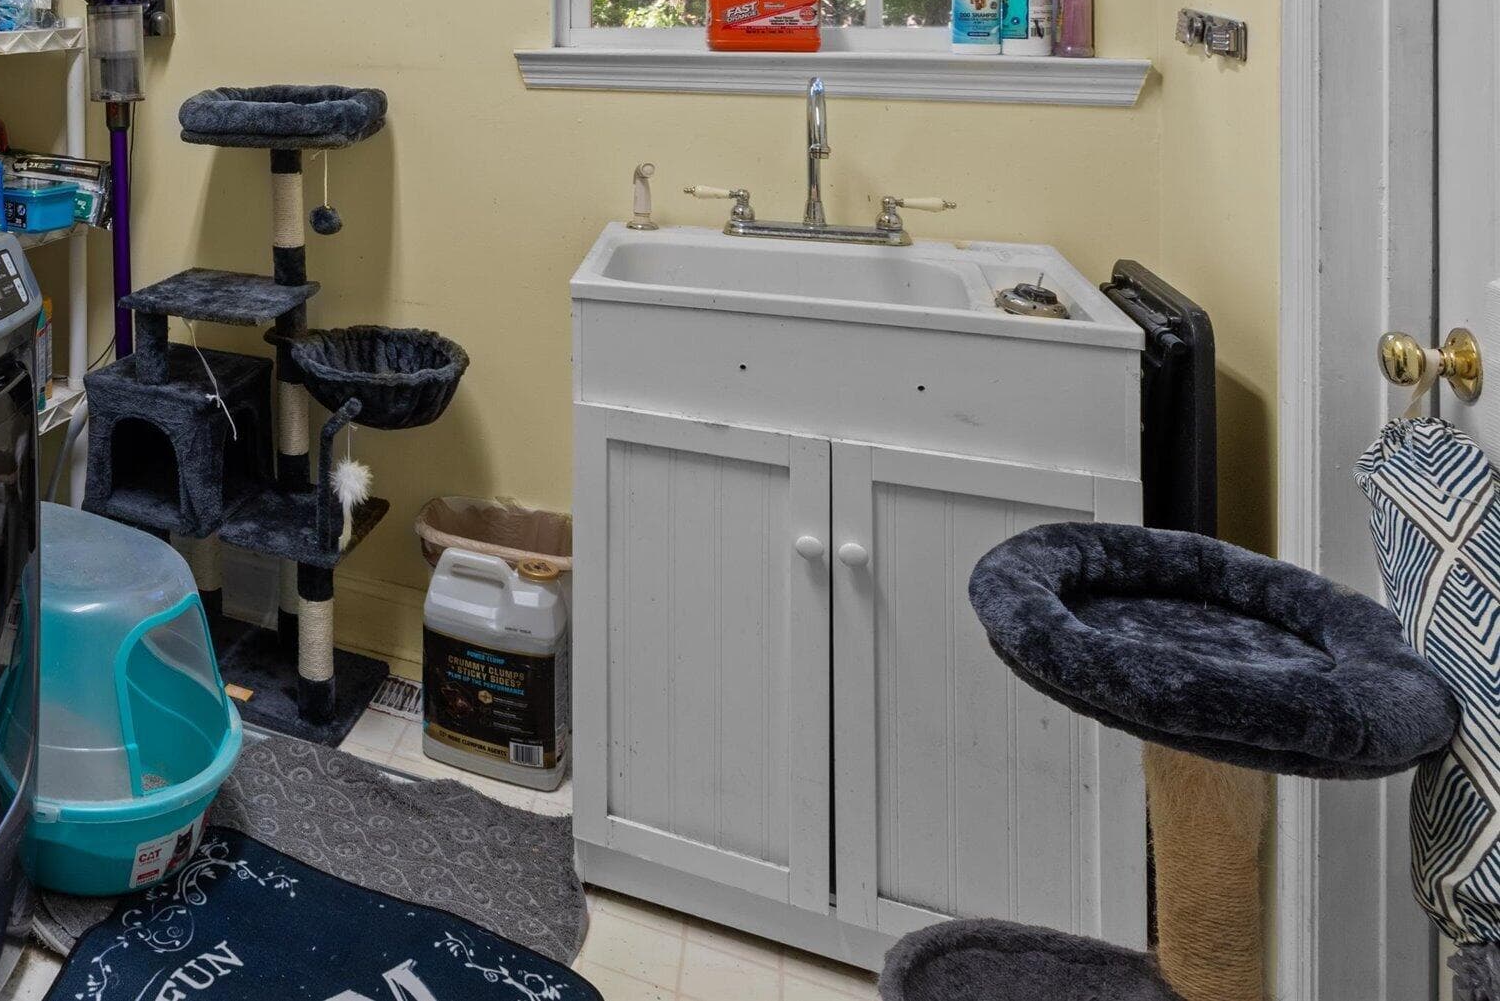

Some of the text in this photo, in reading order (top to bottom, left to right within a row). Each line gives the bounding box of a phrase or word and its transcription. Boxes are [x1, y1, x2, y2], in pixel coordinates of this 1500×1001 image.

[726, 0, 760, 16] FAST
[448, 654, 524, 680] CRUMMY CLUMPS
[457, 666, 522, 688] STICKY SIDES?
